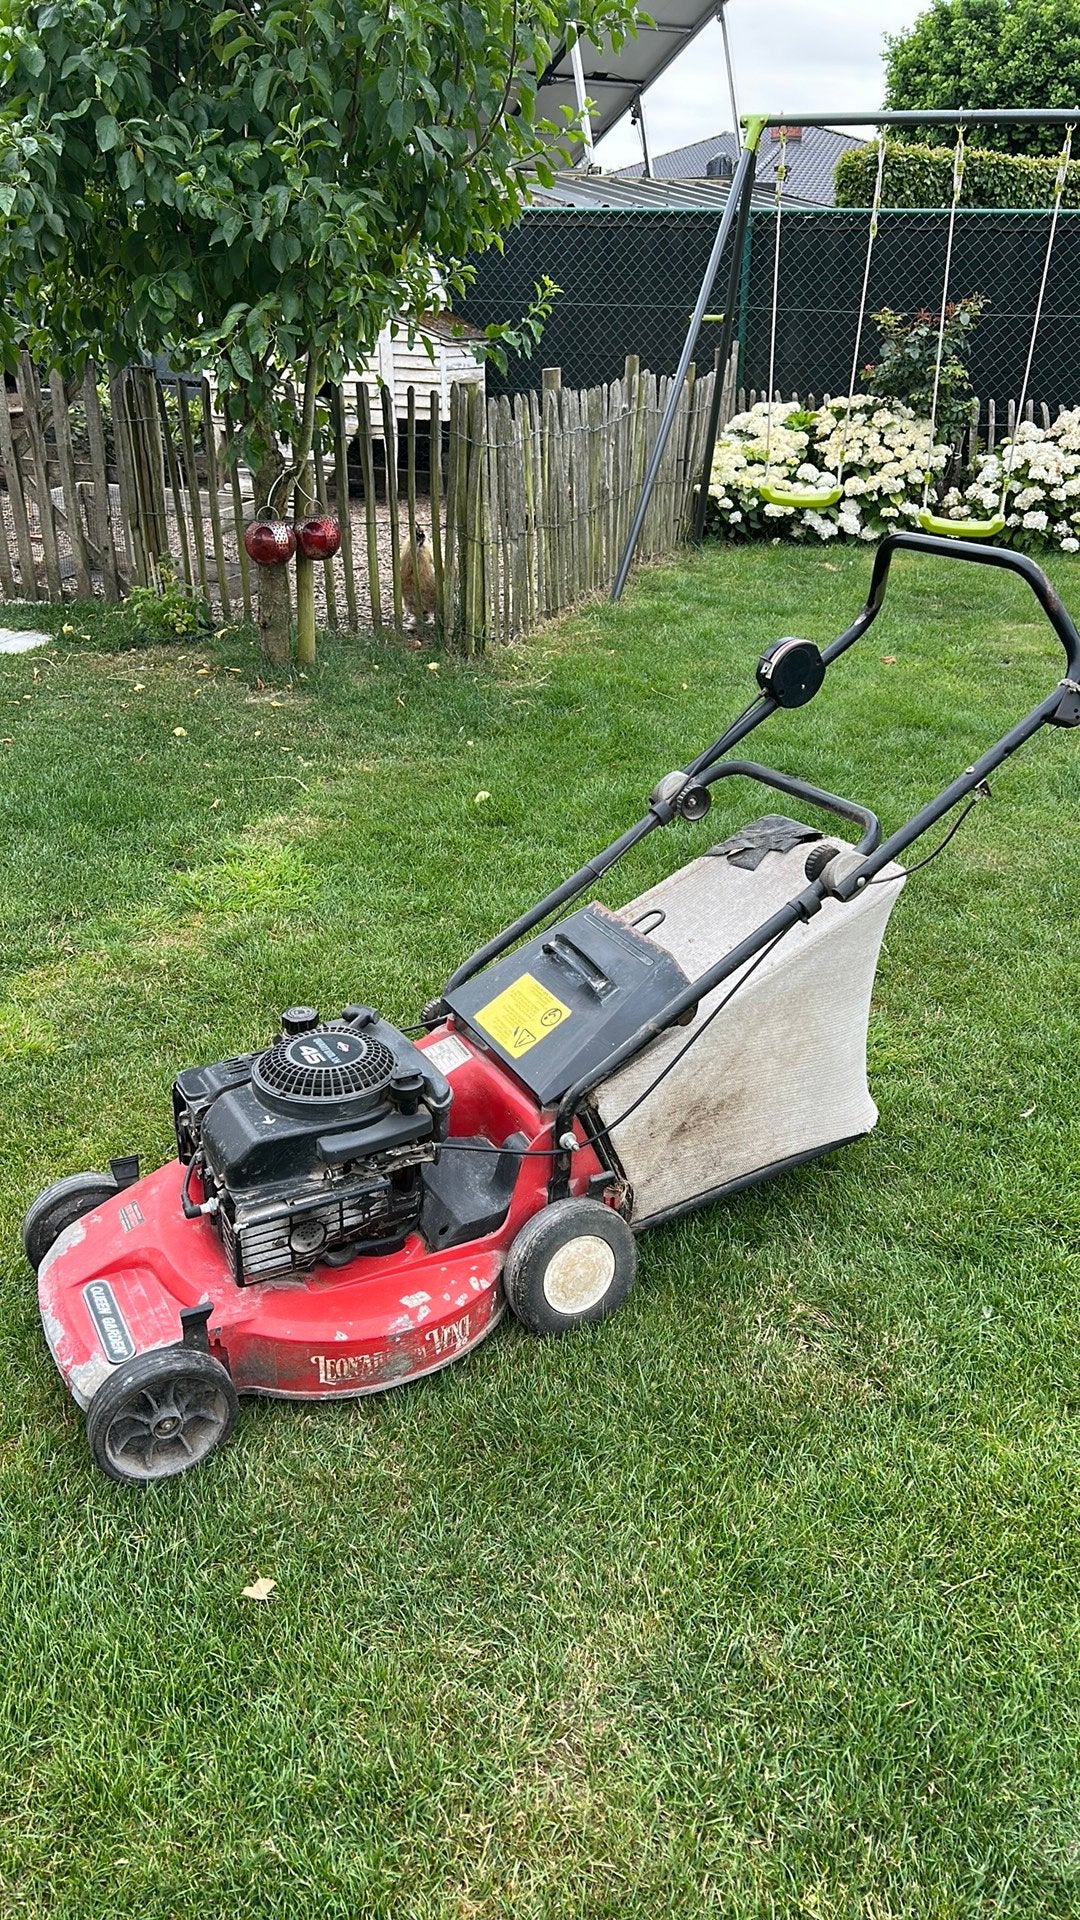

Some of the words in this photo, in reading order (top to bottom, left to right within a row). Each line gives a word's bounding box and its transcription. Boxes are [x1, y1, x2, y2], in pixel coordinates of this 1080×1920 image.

[299, 1045, 327, 1064] 45
[89, 1285, 113, 1315] QUEEN
[101, 1317, 129, 1356] GARDEN
